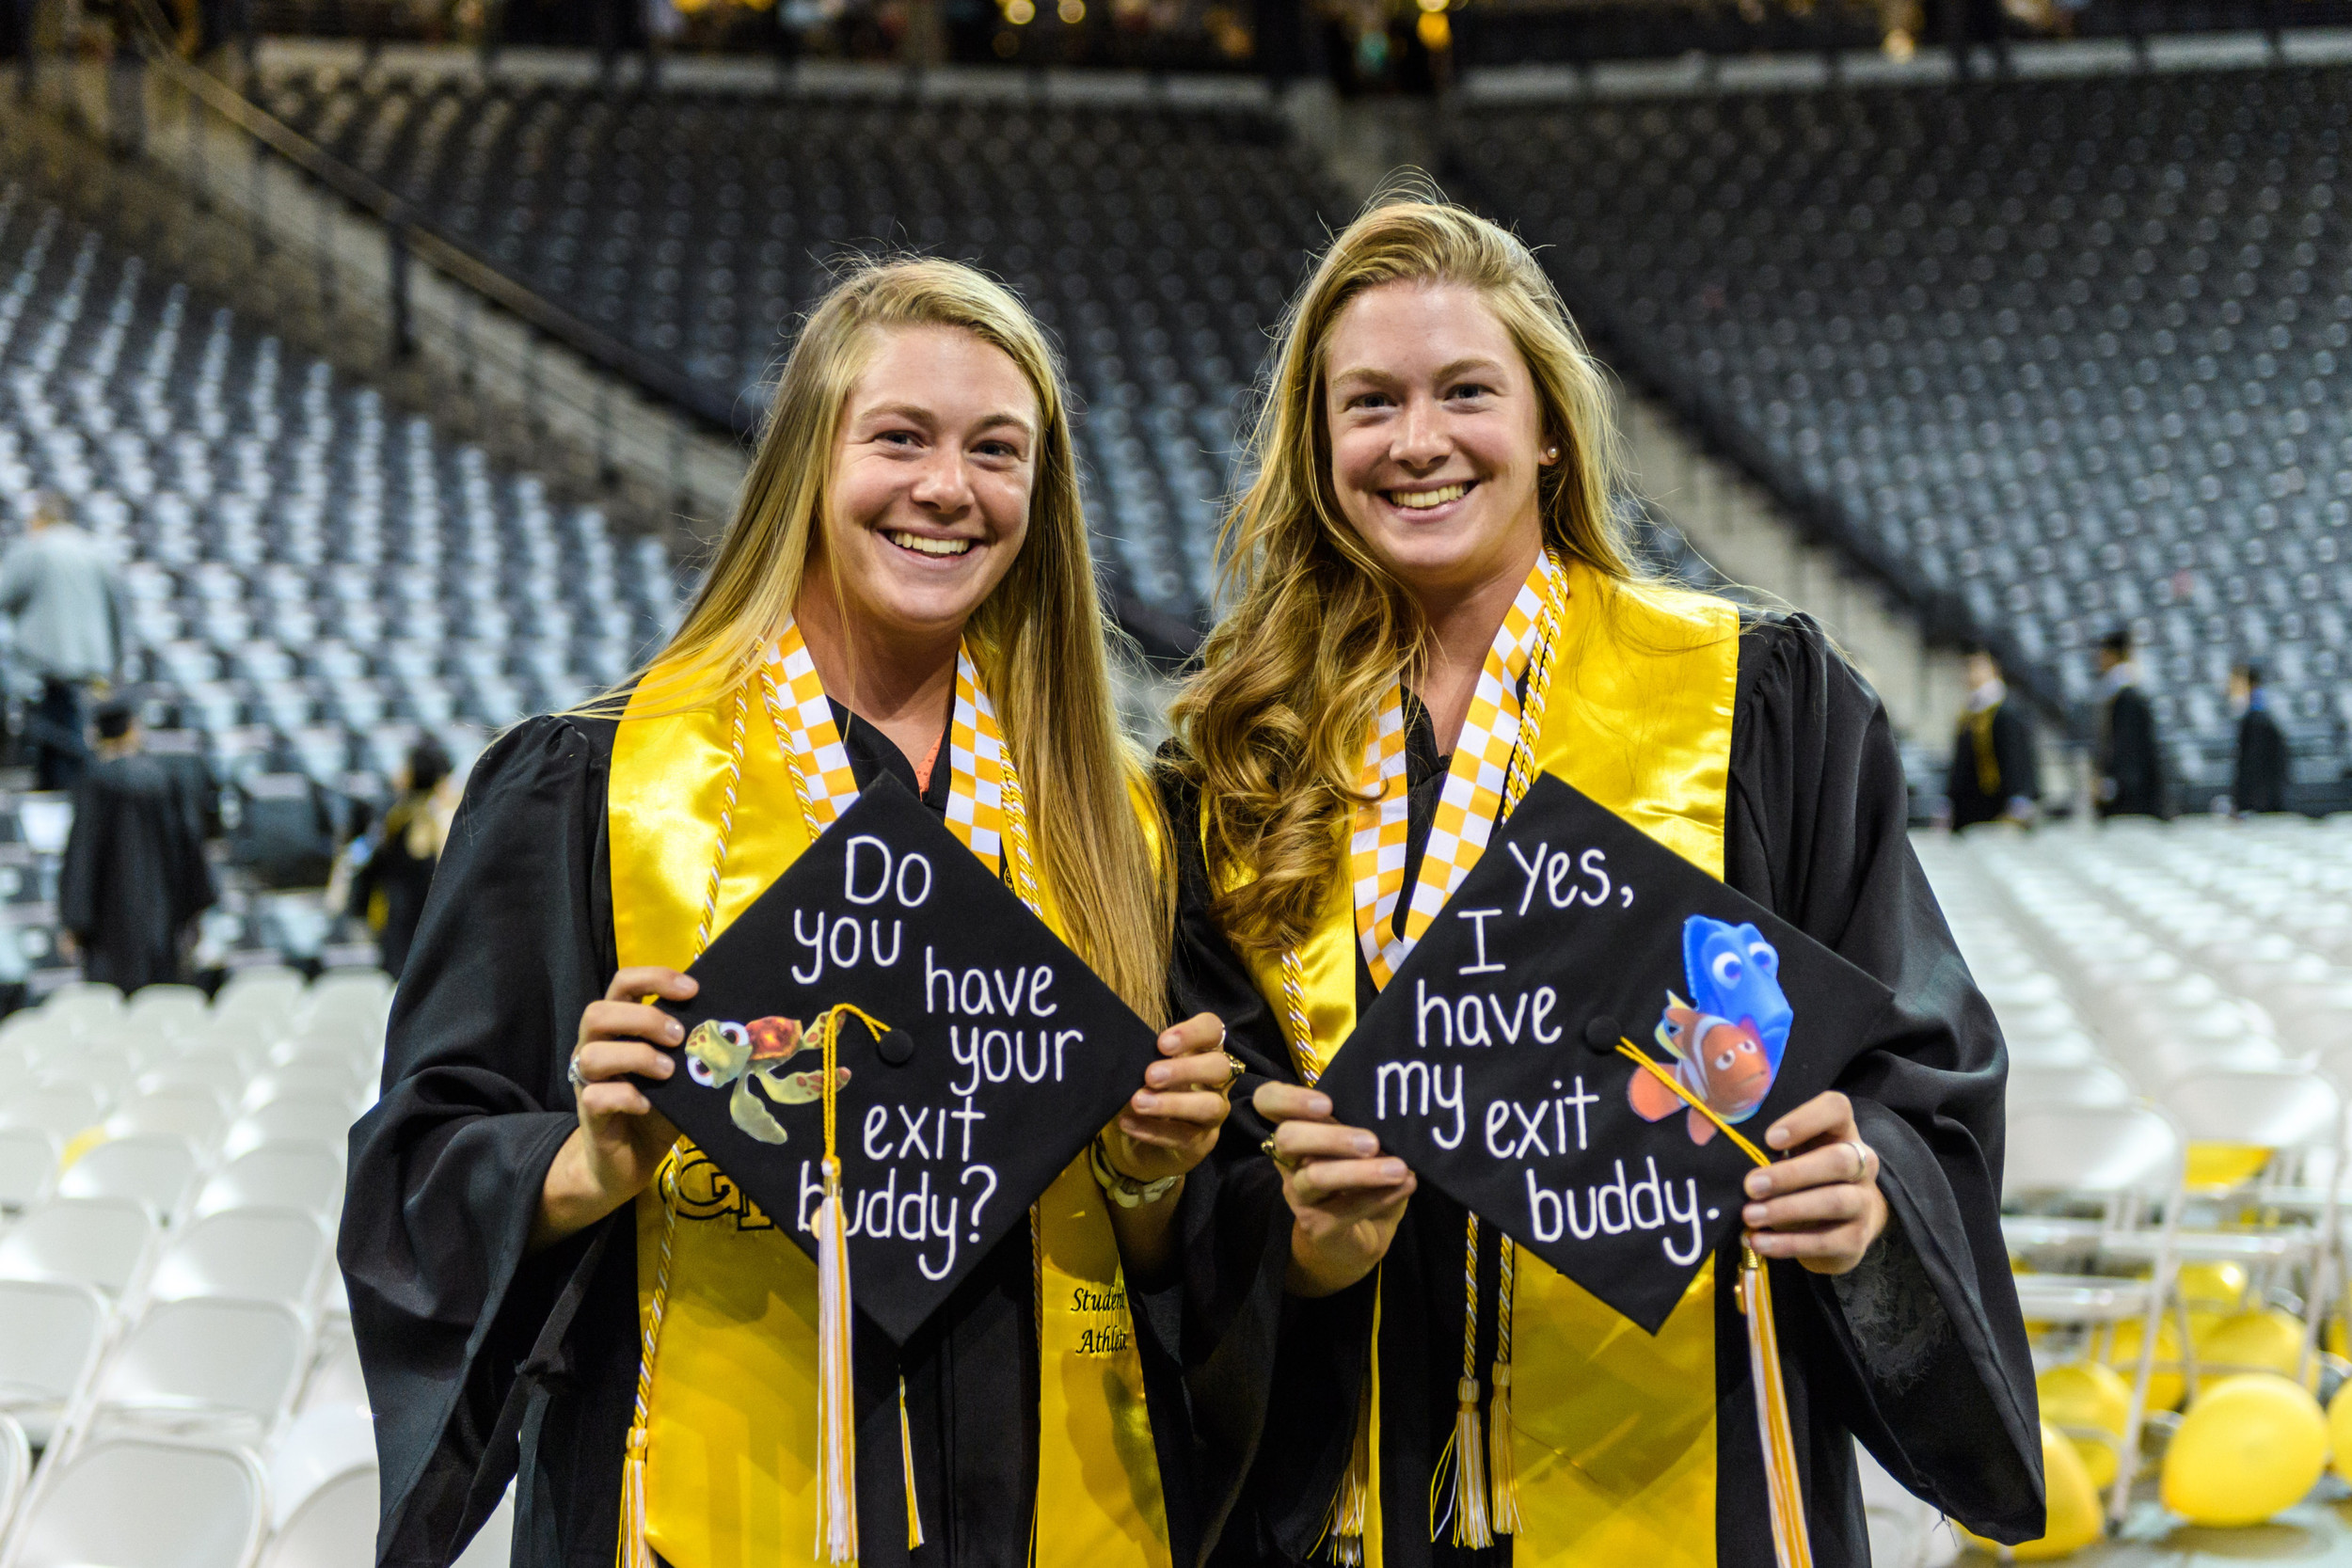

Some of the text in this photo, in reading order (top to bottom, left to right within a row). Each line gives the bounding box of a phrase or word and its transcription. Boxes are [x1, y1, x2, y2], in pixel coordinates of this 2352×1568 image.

[845, 835, 932, 908] Do
[1507, 841, 1635, 916] Yes,
[790, 908, 902, 986] you
[1457, 908, 1507, 976] I
[925, 944, 1058, 1018] have
[1416, 978, 1564, 1049] have
[949, 1024, 1085, 1098] your
[863, 1095, 987, 1163] exit
[1375, 1059, 1600, 1160] my exit
[1524, 1155, 1722, 1267] buddy.
[1070, 1284, 1126, 1312] Student
[1074, 1324, 1128, 1354] Athlete
